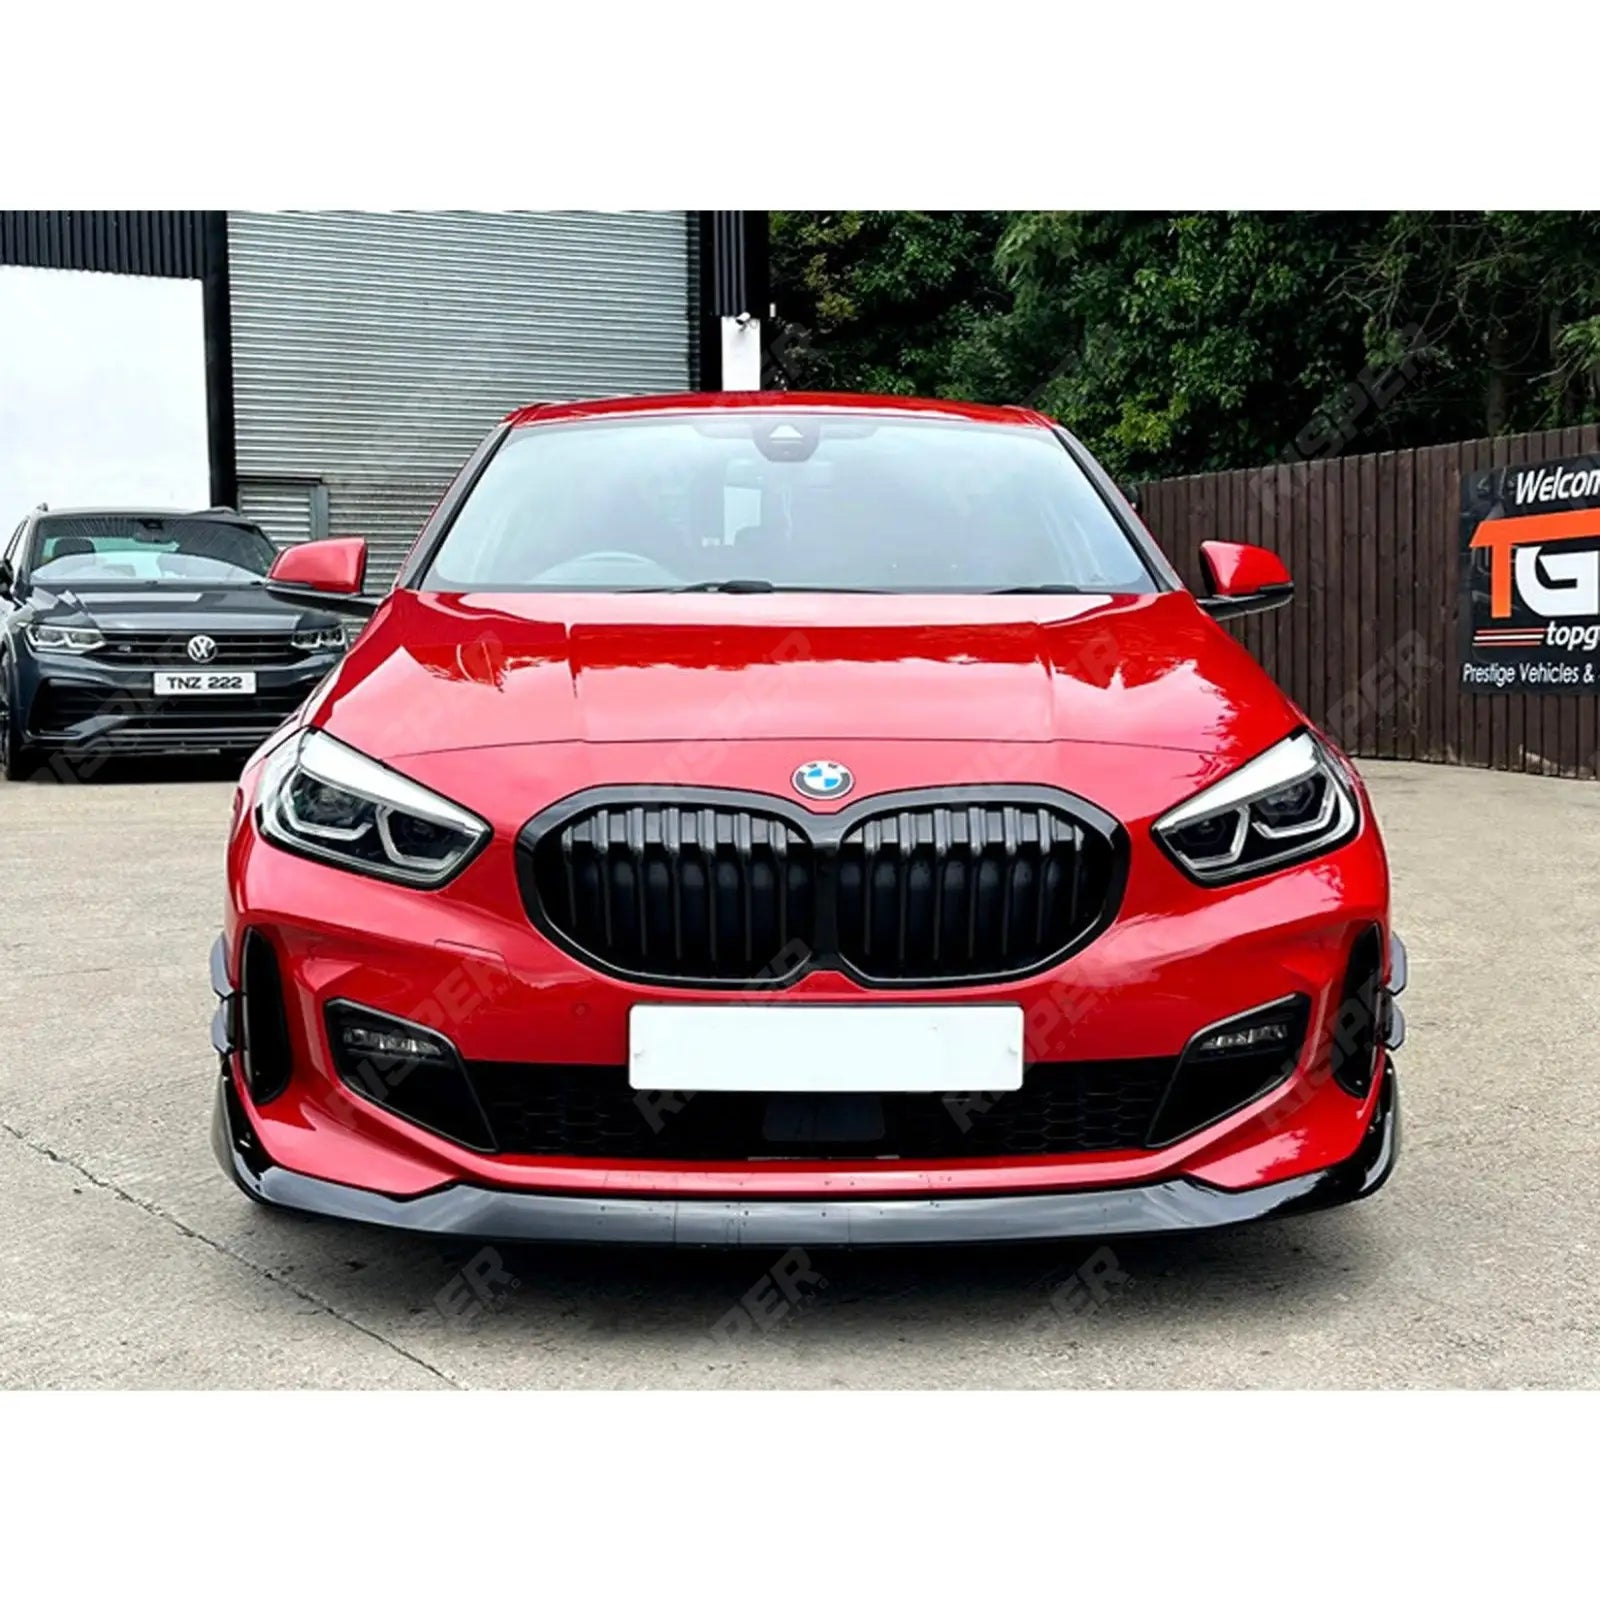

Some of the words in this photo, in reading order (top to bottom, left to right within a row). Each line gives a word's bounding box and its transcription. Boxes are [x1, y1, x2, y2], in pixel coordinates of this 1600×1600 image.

[1546, 620, 1600, 651] topg
[167, 676, 202, 690] TNZ
[207, 676, 243, 689] 222
[1463, 662, 1515, 687] Prestige
[1520, 661, 1579, 683] Vehicles
[1583, 663, 1595, 683] &
